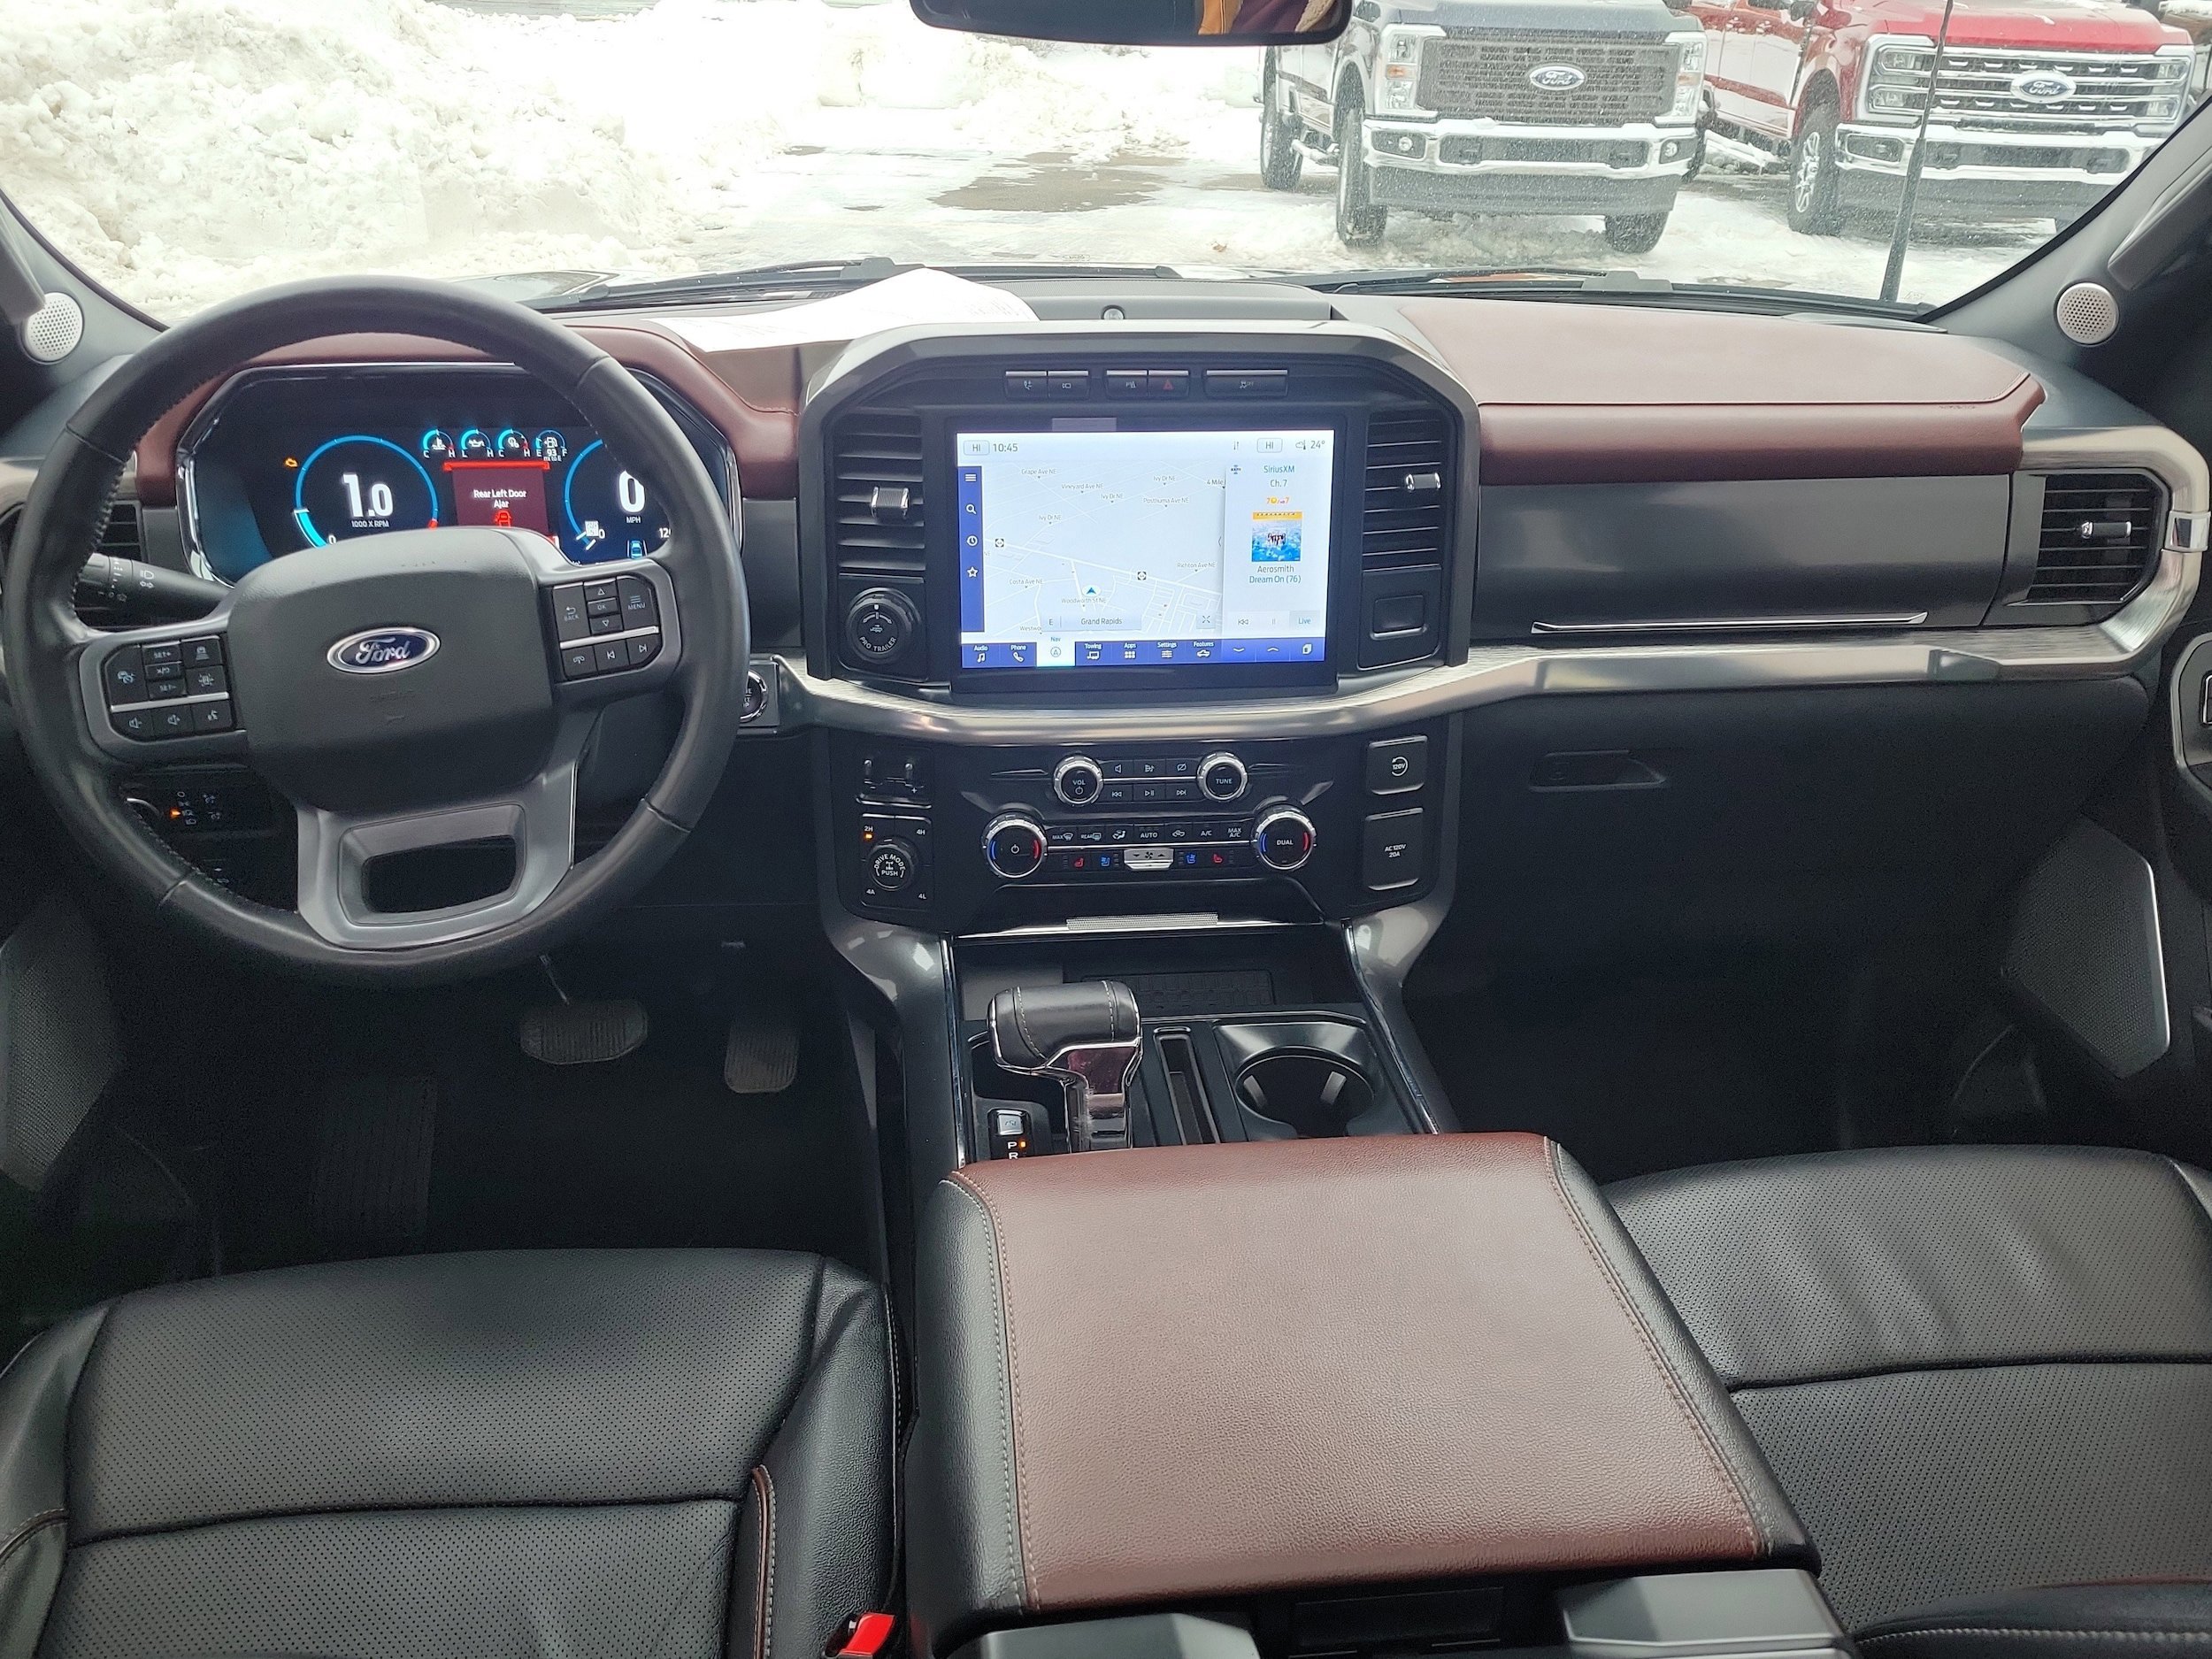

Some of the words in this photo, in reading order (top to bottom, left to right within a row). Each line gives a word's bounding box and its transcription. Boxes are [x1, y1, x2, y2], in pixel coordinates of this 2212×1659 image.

[1542, 71, 1572, 85] Ford
[2029, 81, 2061, 95] Ford
[993, 443, 1018, 452] 10:45
[1310, 440, 1325, 449] 24°
[423, 449, 430, 458] C
[449, 449, 456, 458] H
[461, 449, 468, 458] L
[487, 449, 495, 458] H
[523, 449, 531, 457] H
[536, 449, 542, 457] E
[547, 448, 557, 457] 93
[1263, 465, 1295, 473] SiriusXM
[342, 473, 394, 518] 1.0
[473, 489, 491, 498] Rear
[619, 470, 646, 513] 0
[494, 500, 510, 509] Ajar
[598, 528, 606, 540] 0
[658, 527, 672, 539] 12
[1249, 575, 1273, 584] Dream
[1274, 575, 1285, 584] On
[1286, 575, 1302, 584] (76)
[1101, 617, 1123, 626] Rapids
[859, 636, 872, 649] PRO
[872, 636, 897, 652] TRAILER
[355, 637, 411, 664] Ford
[873, 853, 889, 870] DRIVE
[889, 853, 906, 871] MODE
